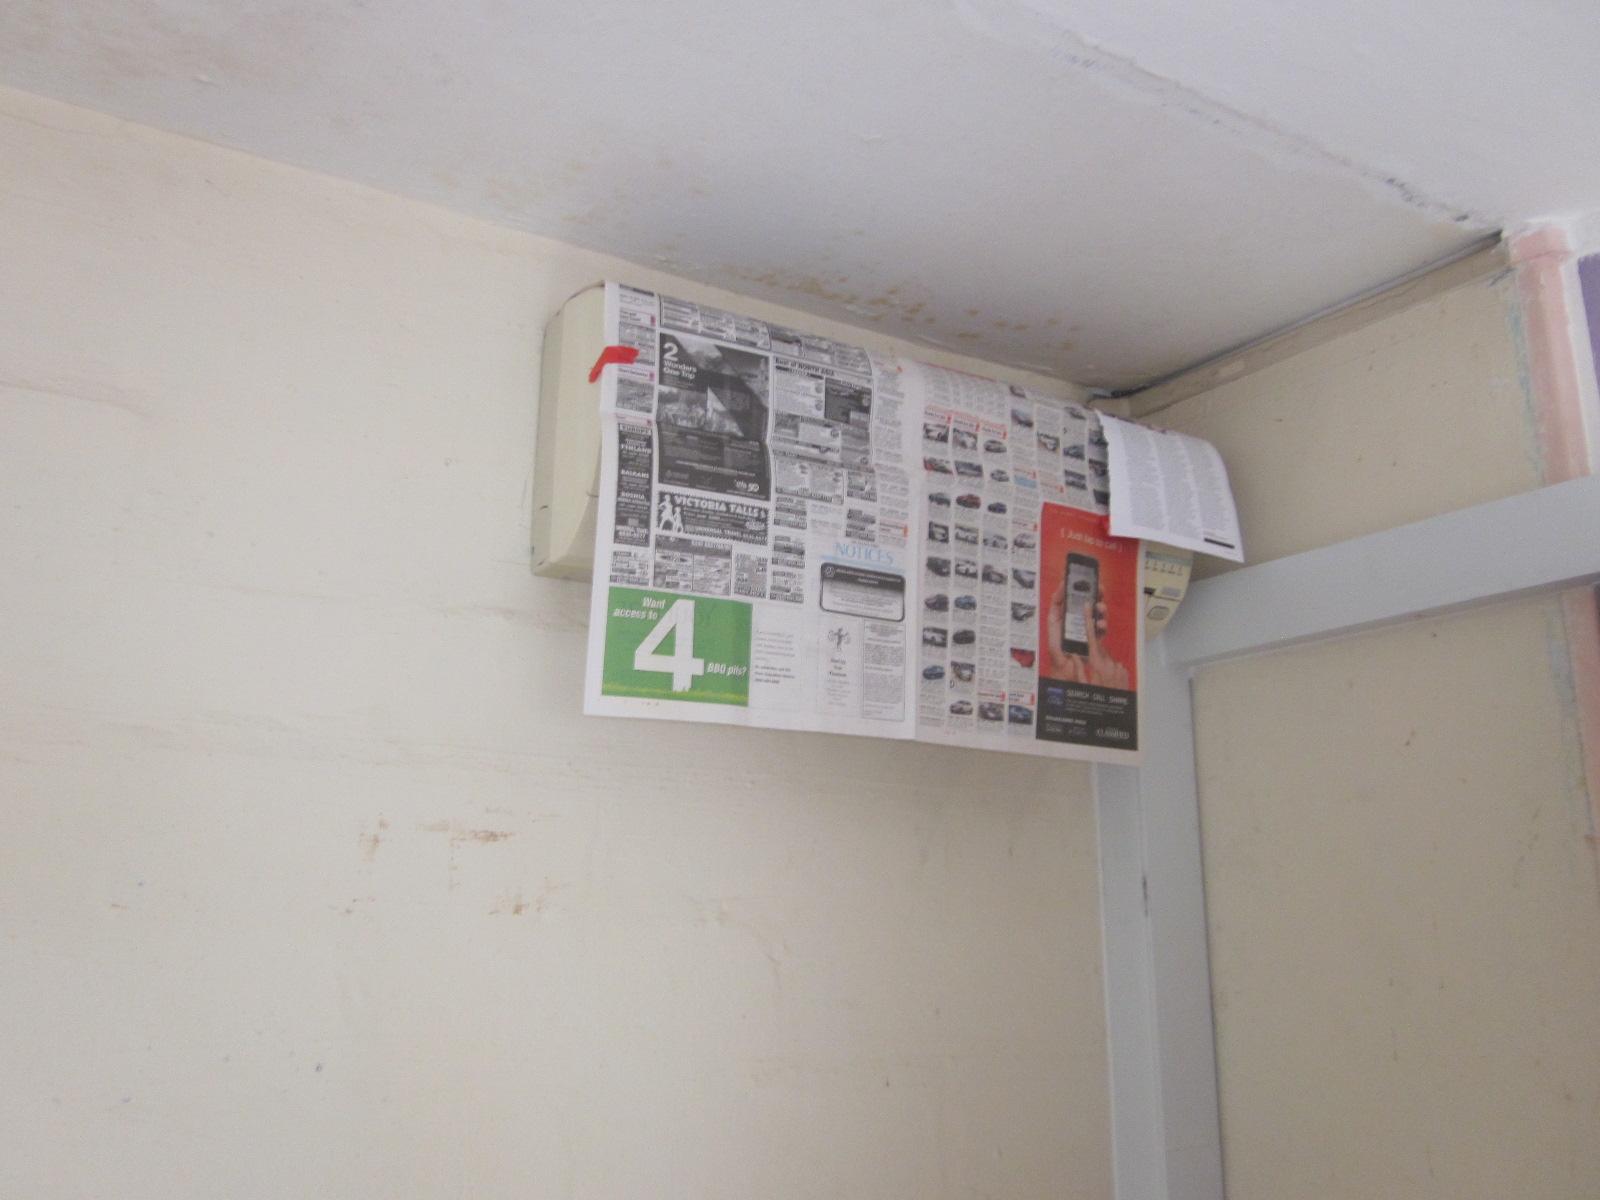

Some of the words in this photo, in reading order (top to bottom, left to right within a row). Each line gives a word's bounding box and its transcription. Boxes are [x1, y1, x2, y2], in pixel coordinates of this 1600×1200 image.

[663, 342, 679, 362] 2
[663, 360, 698, 374] Wonders
[663, 366, 681, 377] One
[674, 495, 728, 513] VICTORIA
[834, 543, 895, 565] NOTICES
[642, 596, 666, 609] Want
[613, 607, 648, 619] access
[647, 610, 659, 621] to
[633, 599, 704, 692] 4
[706, 662, 727, 675] BBQ
